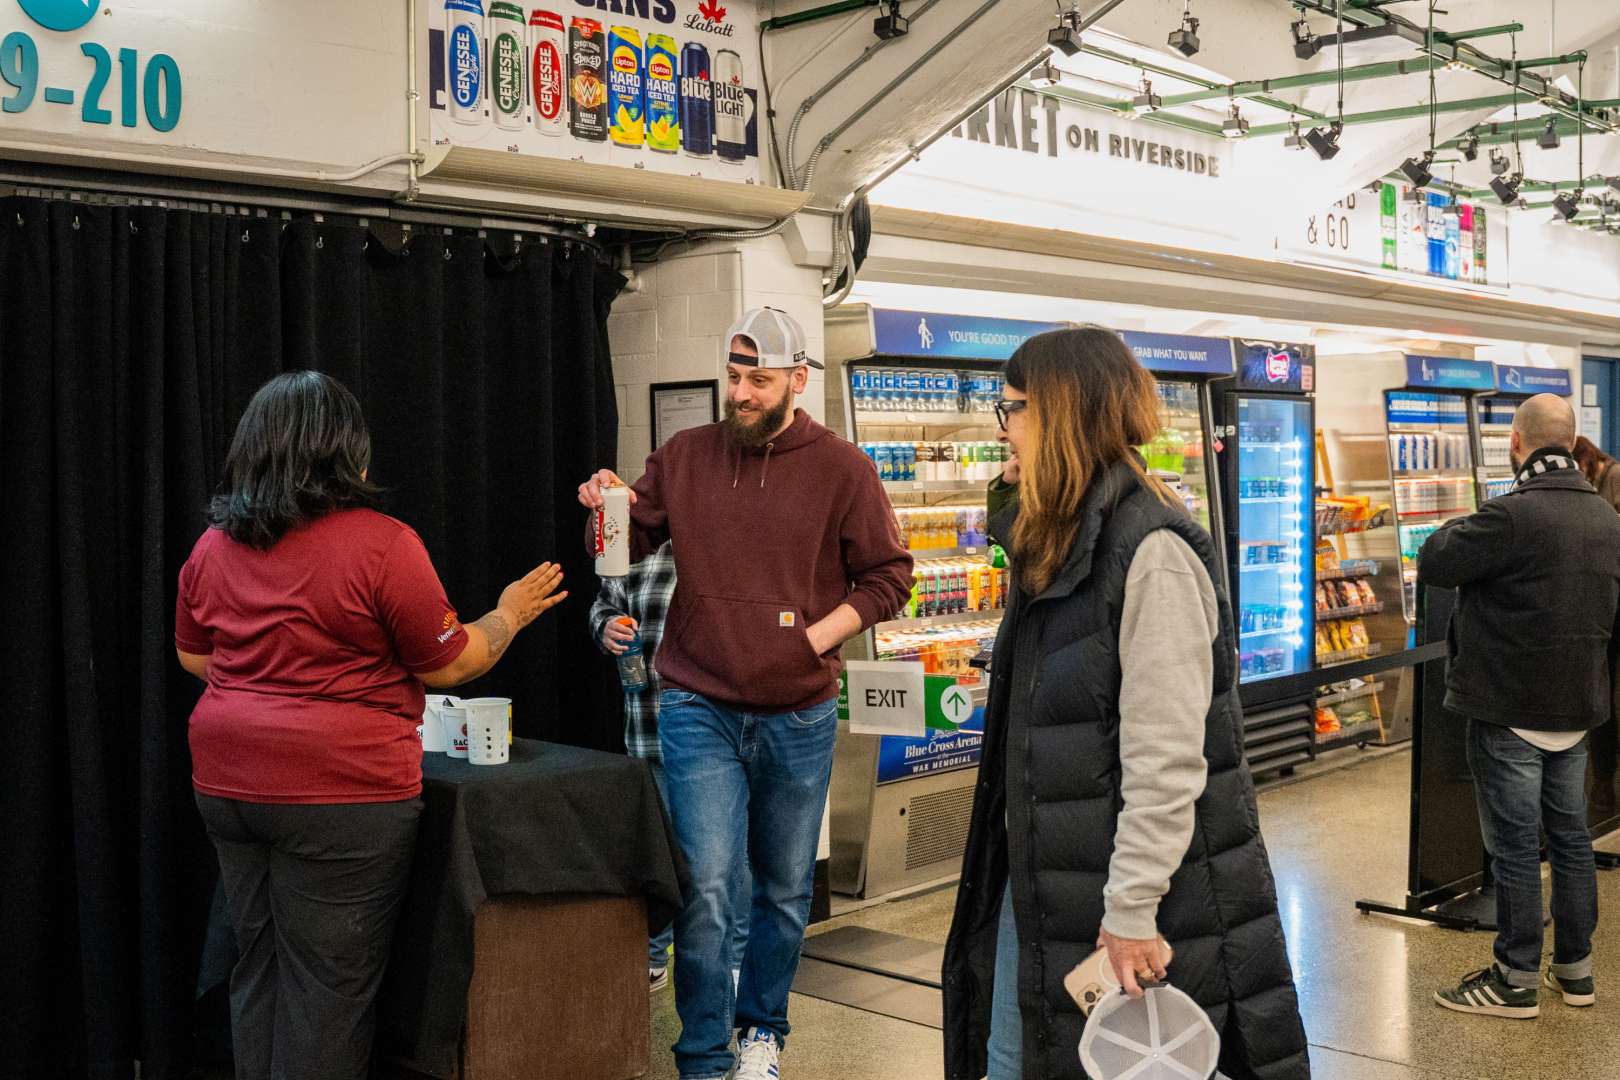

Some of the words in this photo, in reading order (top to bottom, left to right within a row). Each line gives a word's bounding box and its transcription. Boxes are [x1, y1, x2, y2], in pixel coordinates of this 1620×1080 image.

[574, 0, 676, 24] ANS
[683, 14, 734, 37] Labatt
[456, 30, 470, 103] GENESEE
[615, 57, 634, 67] Lipton
[652, 64, 670, 75] Lipton
[499, 39, 513, 110] GENESEE
[540, 46, 553, 116] GENESEE
[610, 70, 640, 87] HARD
[612, 83, 626, 93] ICED
[627, 86, 640, 95] TEA
[647, 78, 676, 95] HARD
[681, 77, 711, 101] Blue
[715, 81, 744, 103] Blue
[647, 91, 662, 100] ICED
[662, 93, 675, 102] TEA
[716, 100, 744, 117] LIGHT
[952, 87, 1060, 157] RKET
[1067, 124, 1099, 152] ON
[1109, 133, 1219, 177] RIVERSIDE
[1327, 213, 1349, 250] GO
[948, 330, 979, 344] YOU'RE
[980, 332, 1007, 345] GOOD
[1008, 334, 1019, 346] TO
[1152, 348, 1173, 359] WHAT
[1173, 350, 1188, 360] YOU
[1188, 351, 1207, 361] WANT
[865, 689, 907, 708] EXIT
[453, 738, 469, 746] BAC
[905, 745, 927, 759] Blue
[928, 740, 955, 753] Cross
[956, 736, 982, 748] Arena
[912, 763, 929, 773] WAR
[932, 755, 971, 769] MEMORIAL
